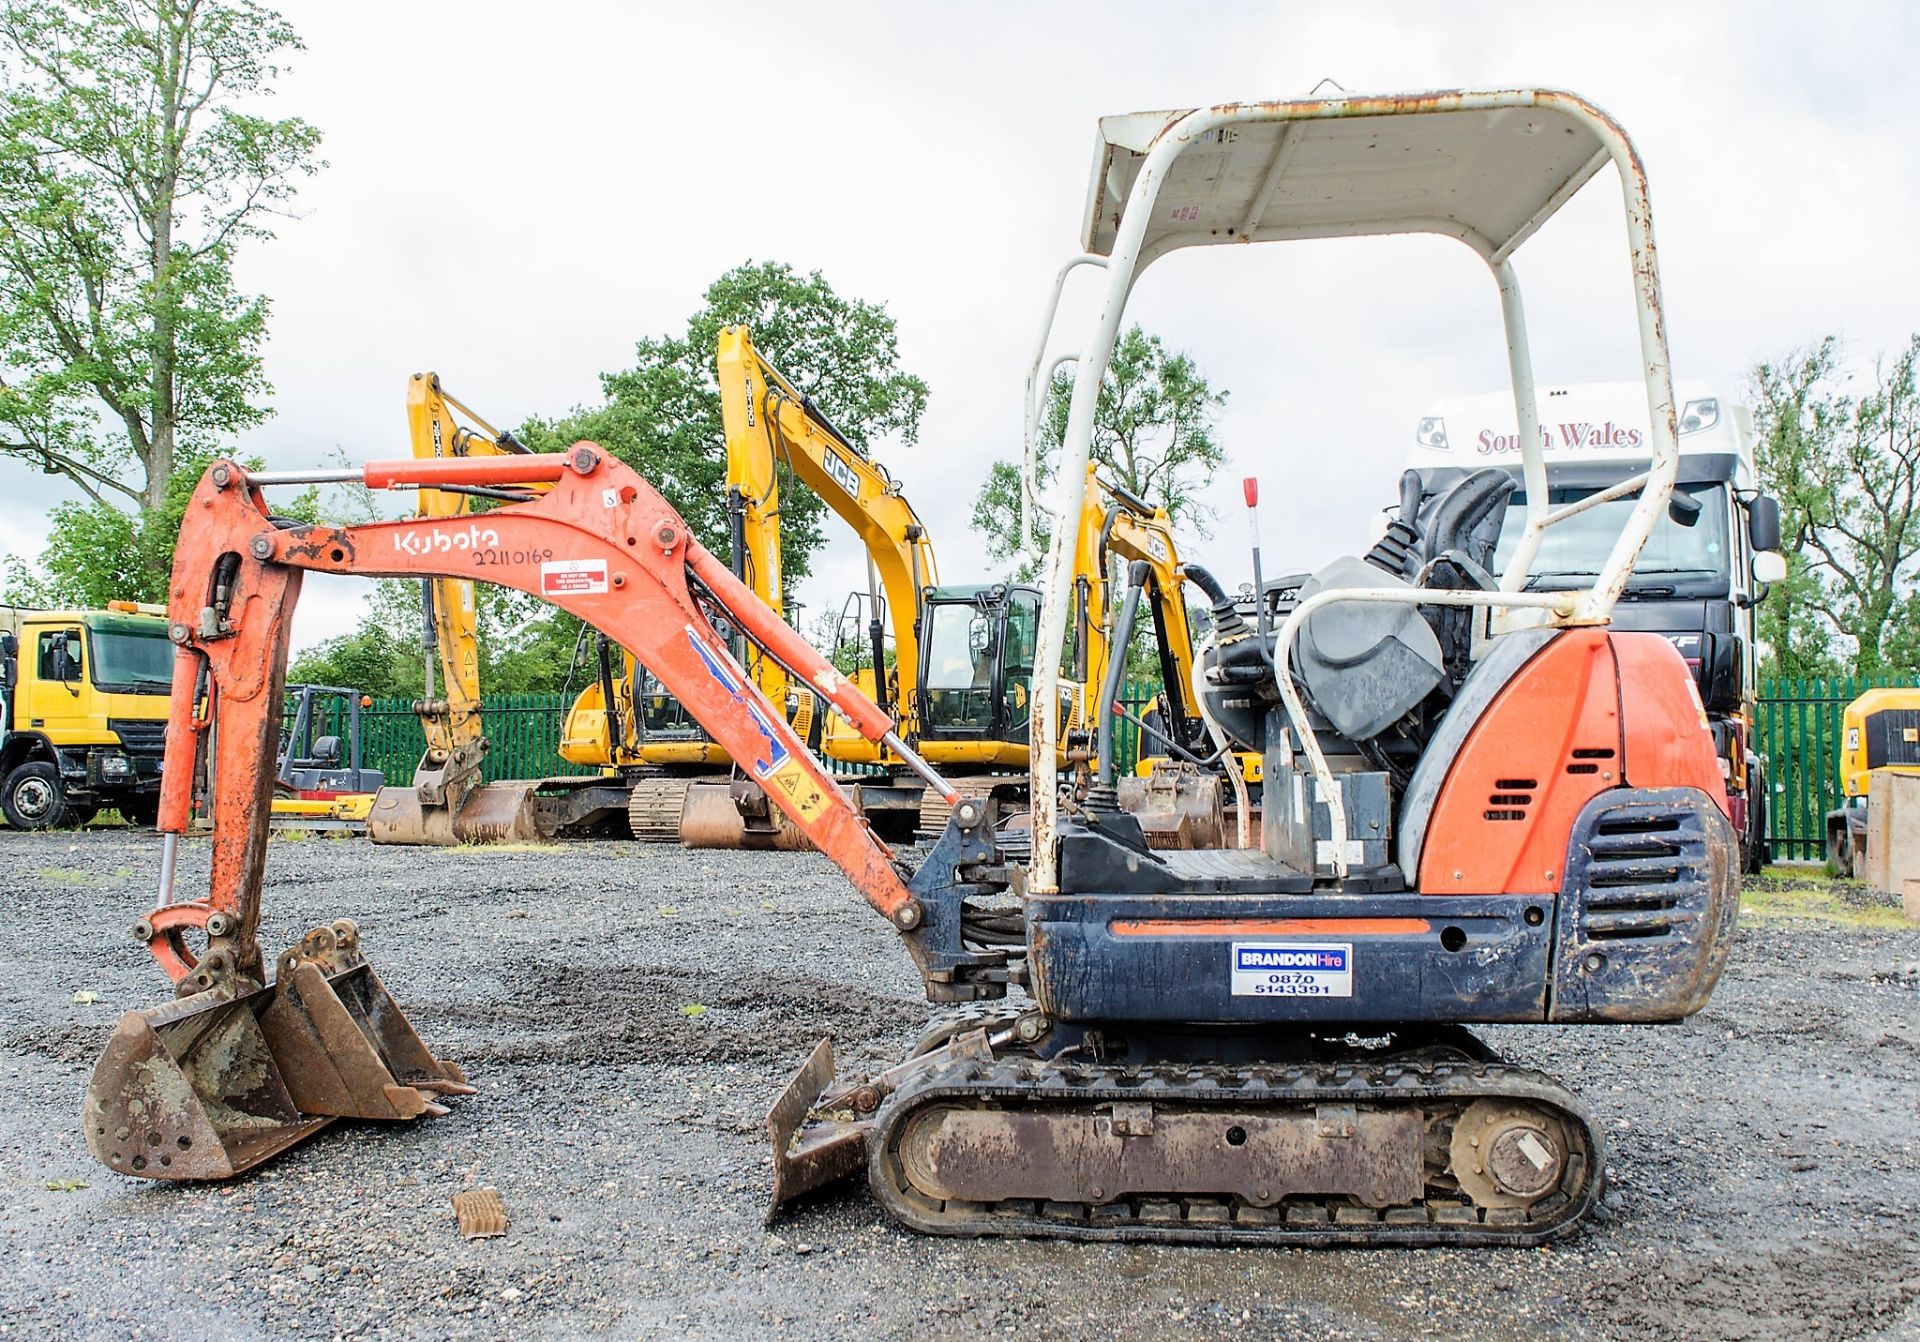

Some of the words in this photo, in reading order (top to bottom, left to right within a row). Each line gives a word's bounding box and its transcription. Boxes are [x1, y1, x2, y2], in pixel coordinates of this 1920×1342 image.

[1477, 426, 1552, 454] Souh
[1559, 421, 1641, 448] Wales
[823, 446, 860, 499] JCB
[394, 525, 499, 555] Kubota
[1147, 533, 1166, 562] JCB
[472, 549, 553, 566] 22110169
[1255, 984, 1330, 994] 5143391
[1268, 974, 1315, 984] 0870
